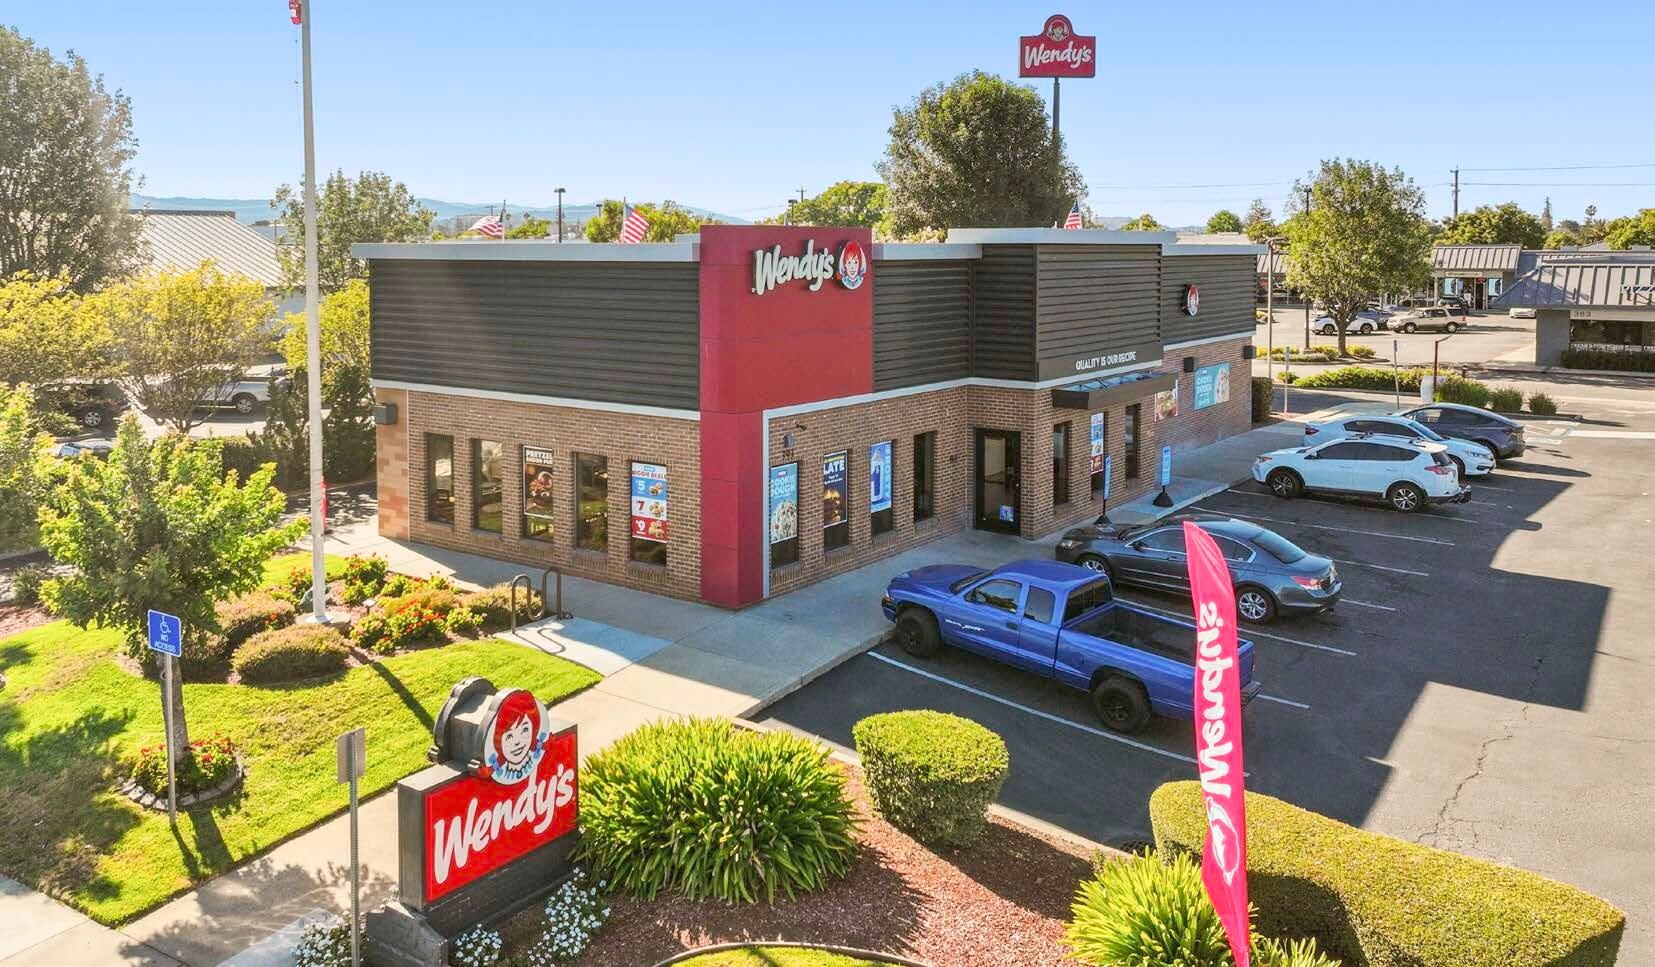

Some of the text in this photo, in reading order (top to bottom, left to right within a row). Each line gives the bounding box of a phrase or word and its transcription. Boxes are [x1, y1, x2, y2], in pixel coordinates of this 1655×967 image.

[1024, 41, 1092, 69] Wendy's
[755, 239, 835, 296] Wendy's
[1075, 351, 1137, 371] QUALITY IS OUR RECIPE
[526, 450, 553, 460] PRETZEL
[823, 460, 845, 475] LATE
[160, 633, 169, 642] NO
[154, 640, 177, 653] ACCESS
[433, 763, 574, 884] Wendy's
